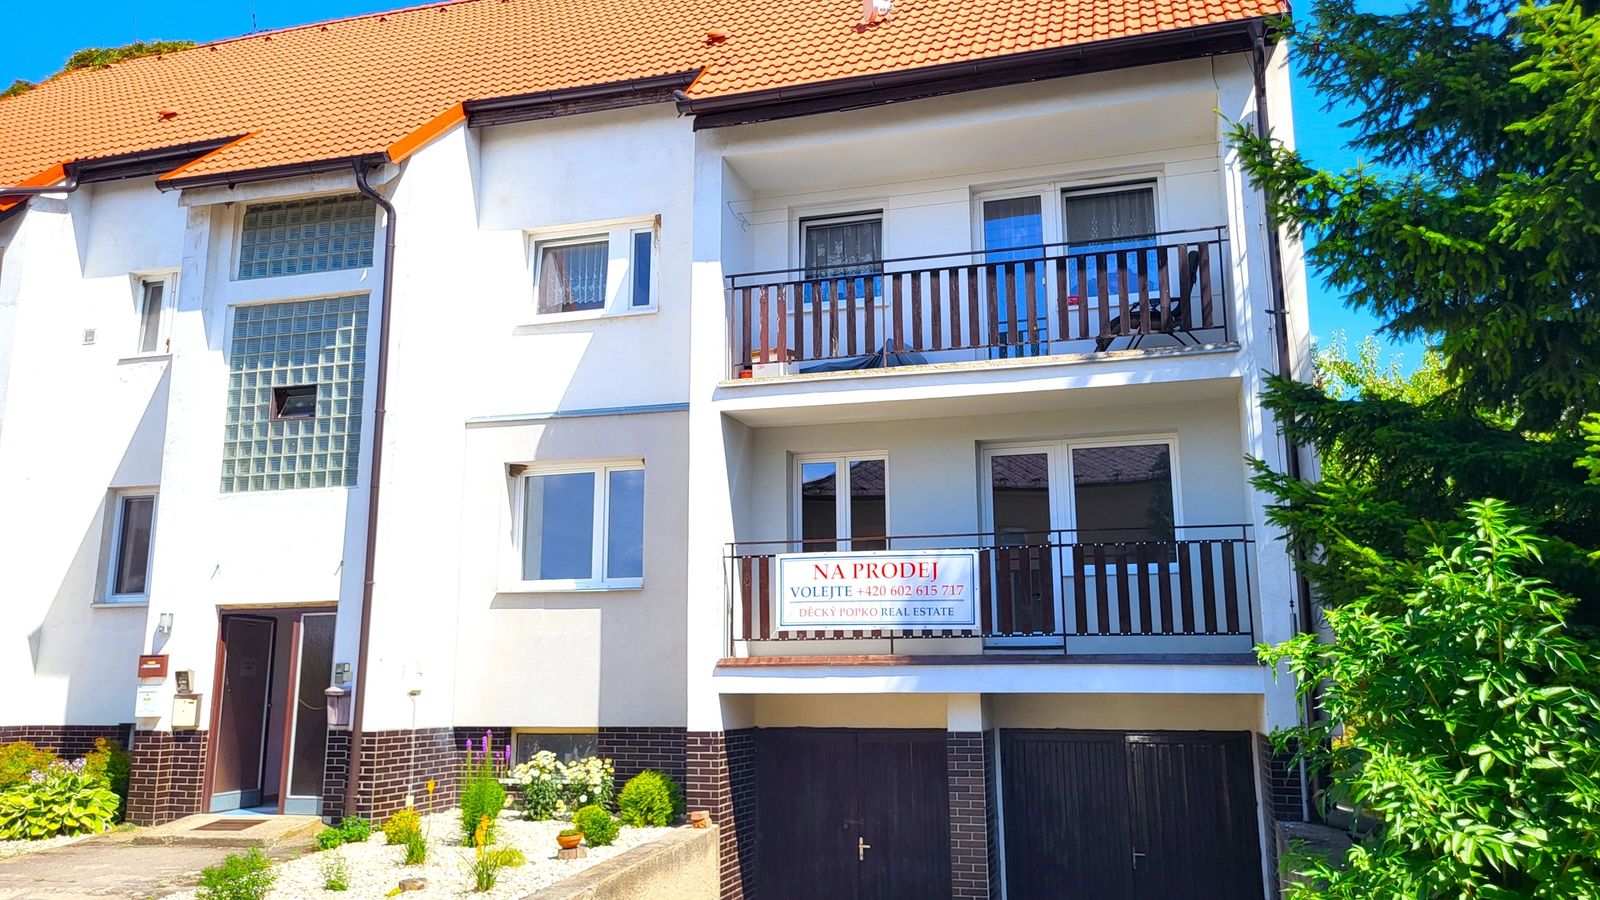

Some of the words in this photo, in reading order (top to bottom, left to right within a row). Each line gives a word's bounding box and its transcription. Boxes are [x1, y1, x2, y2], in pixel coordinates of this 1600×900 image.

[813, 563, 845, 580] NA
[853, 561, 940, 582] PRODEJ
[790, 585, 853, 599] VOLEJTE
[857, 585, 886, 597] +420
[890, 585, 912, 596] 602
[916, 585, 938, 596] 615
[942, 584, 964, 596] 717
[799, 606, 837, 617] DĚCKÝ
[839, 607, 878, 617] POPKO
[880, 607, 910, 617] REAL
[913, 606, 954, 617] ESTATE
